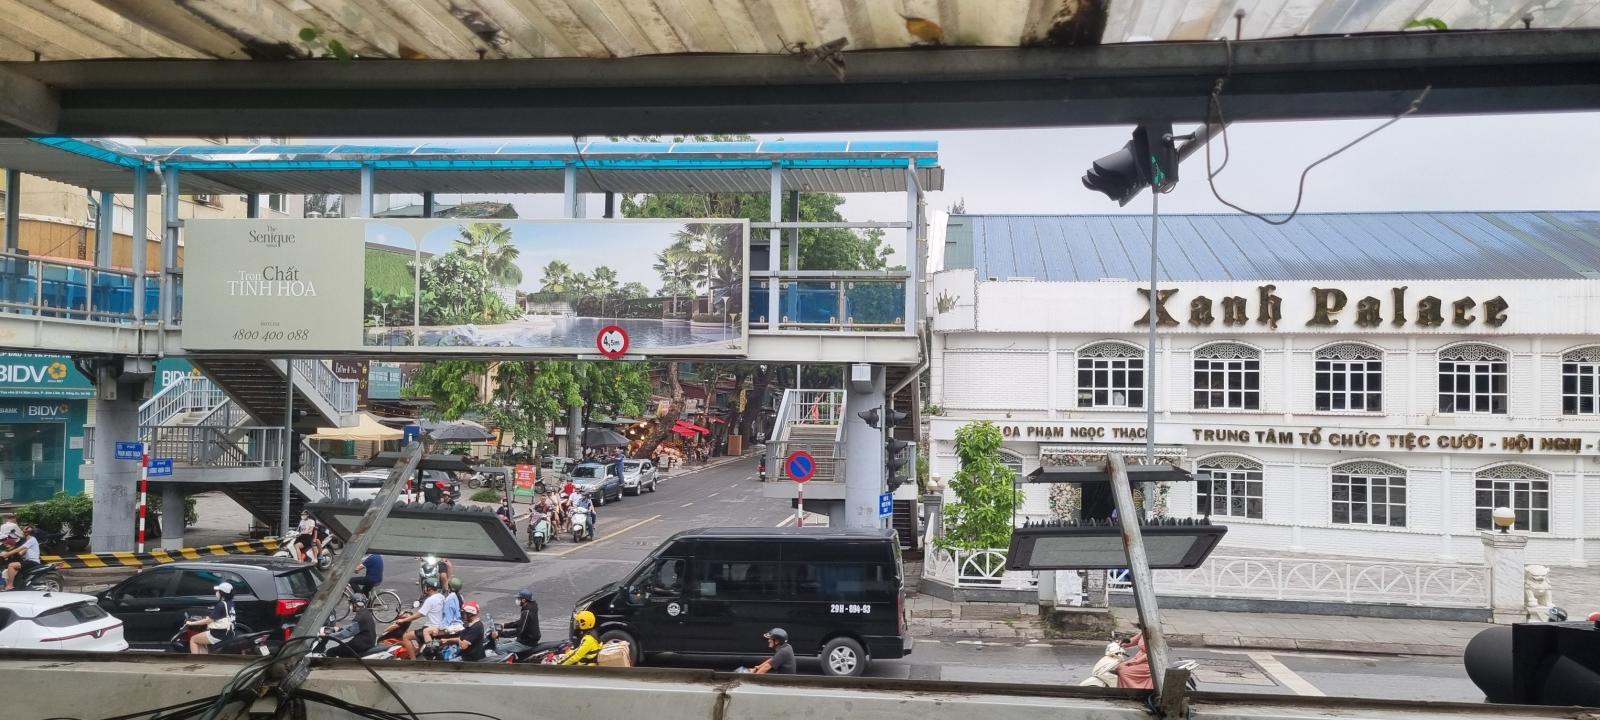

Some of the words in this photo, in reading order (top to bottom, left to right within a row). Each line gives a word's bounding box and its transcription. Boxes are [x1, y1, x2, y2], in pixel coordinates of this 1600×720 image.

[249, 229, 296, 247] Senique
[262, 264, 300, 281] Chất
[227, 280, 272, 297] TINH
[277, 280, 317, 297] HOA
[1133, 284, 1284, 330] Xanh
[1305, 285, 1510, 329] Palace
[232, 328, 259, 341] 1800
[262, 330, 284, 342] 400
[287, 328, 310, 341] 088
[0, 365, 48, 382] BIDV
[28, 405, 58, 416] BIDV
[1027, 426, 1064, 440] PHẠM
[1070, 426, 1105, 441] NGỌC
[1192, 428, 1250, 443] TRUNG
[1255, 428, 1294, 444] TÂM
[1299, 426, 1322, 445] TỔ
[1328, 430, 1381, 447] CHỨC
[1387, 432, 1430, 450] TIỆC
[1502, 433, 1534, 453] HỘI
[1540, 437, 1582, 454] NGHỊ
[830, 603, 845, 613] 29H
